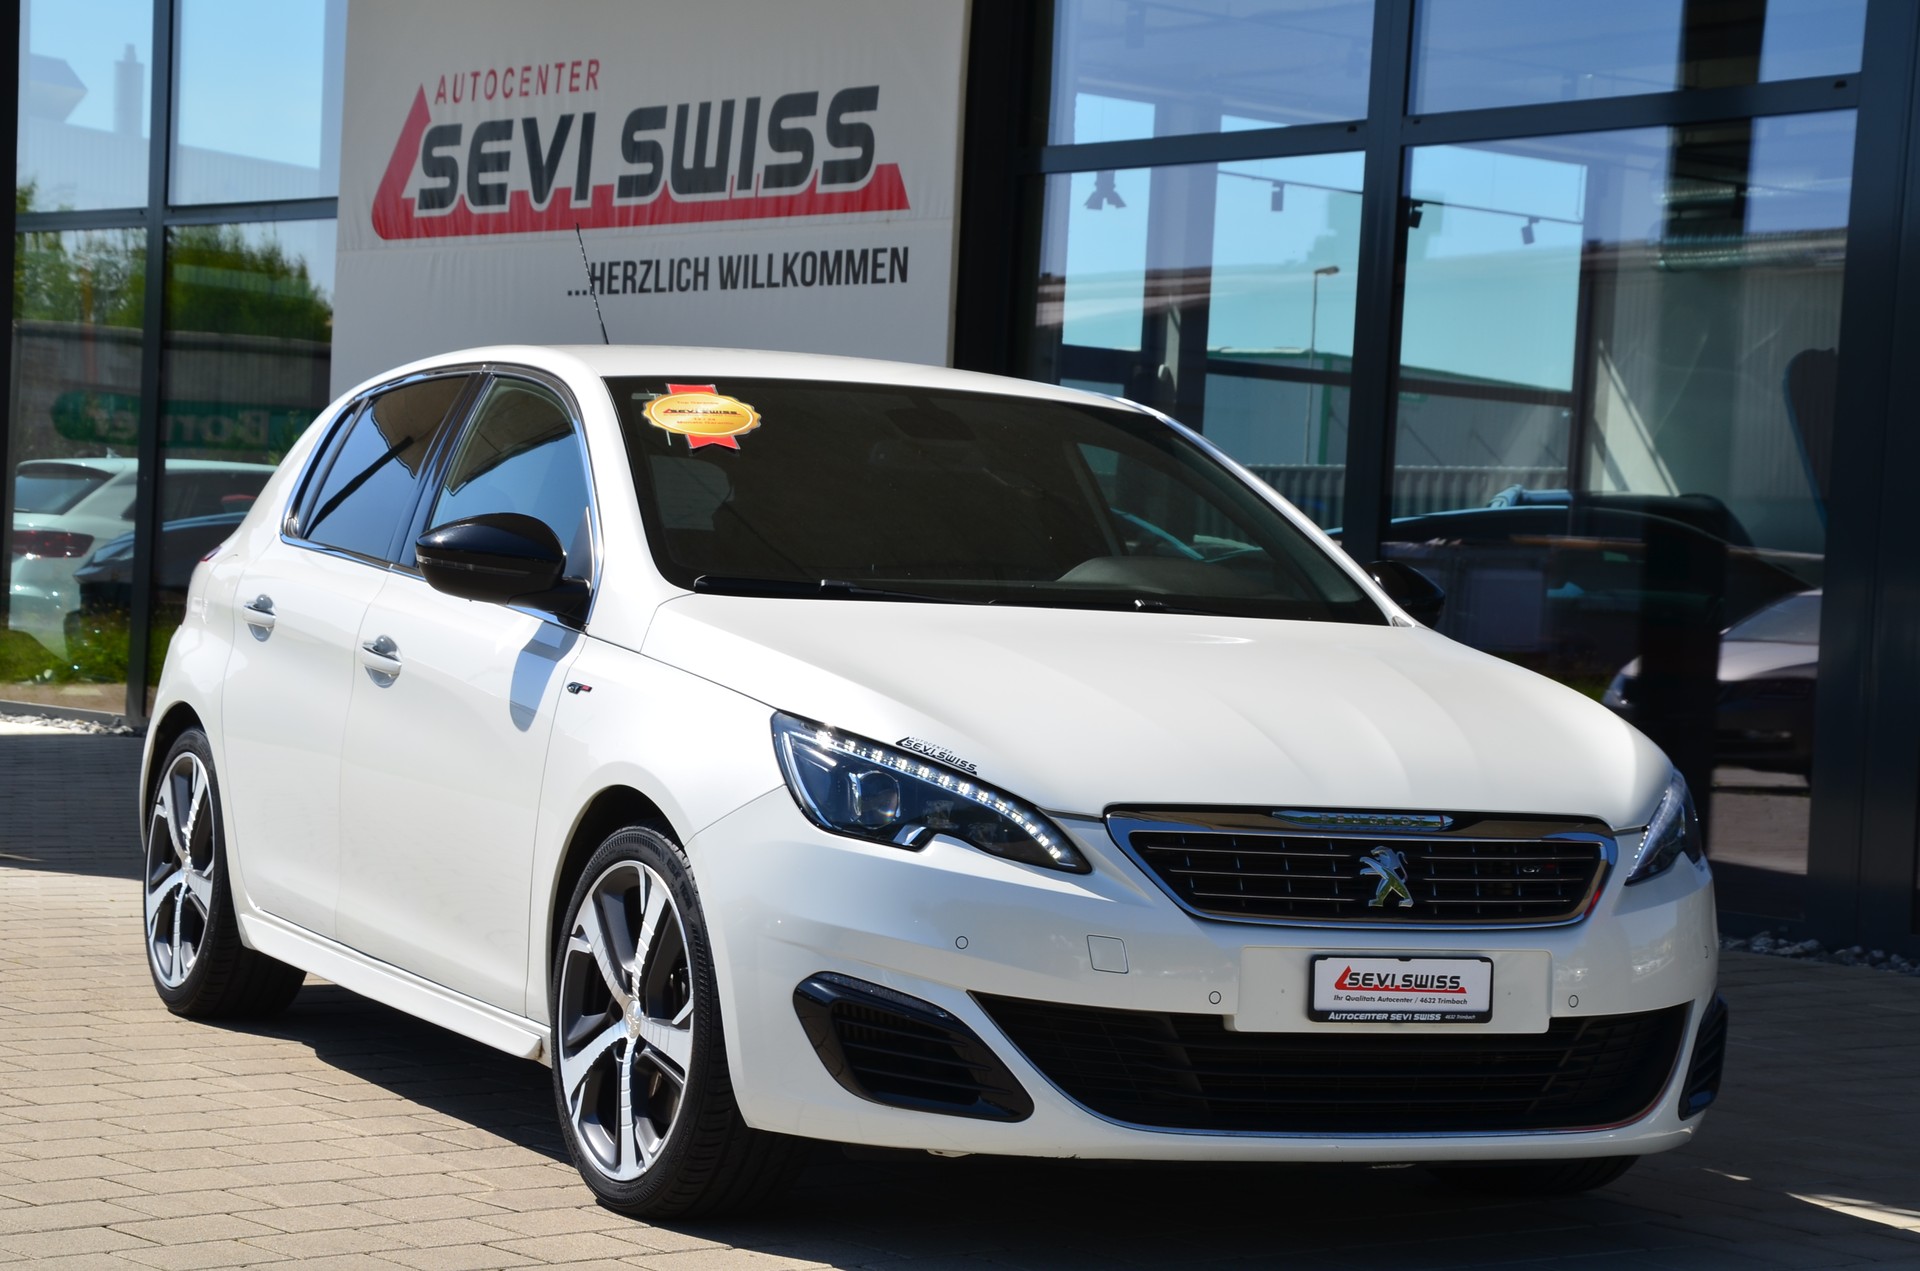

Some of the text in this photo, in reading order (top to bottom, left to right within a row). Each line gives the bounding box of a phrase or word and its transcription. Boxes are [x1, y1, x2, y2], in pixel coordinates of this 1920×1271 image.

[434, 59, 600, 104] AUTOCENTER
[417, 85, 880, 210] SEVI SWISS
[718, 246, 909, 290] WILLKOMMEN
[904, 739, 977, 771] SEVI SWISS
[1320, 813, 1425, 826] PEUGEOT
[1348, 972, 1461, 990] SEVI SWISS
[1390, 1013, 1412, 1021] SEVI
[1413, 1013, 1441, 1021] SWISS
